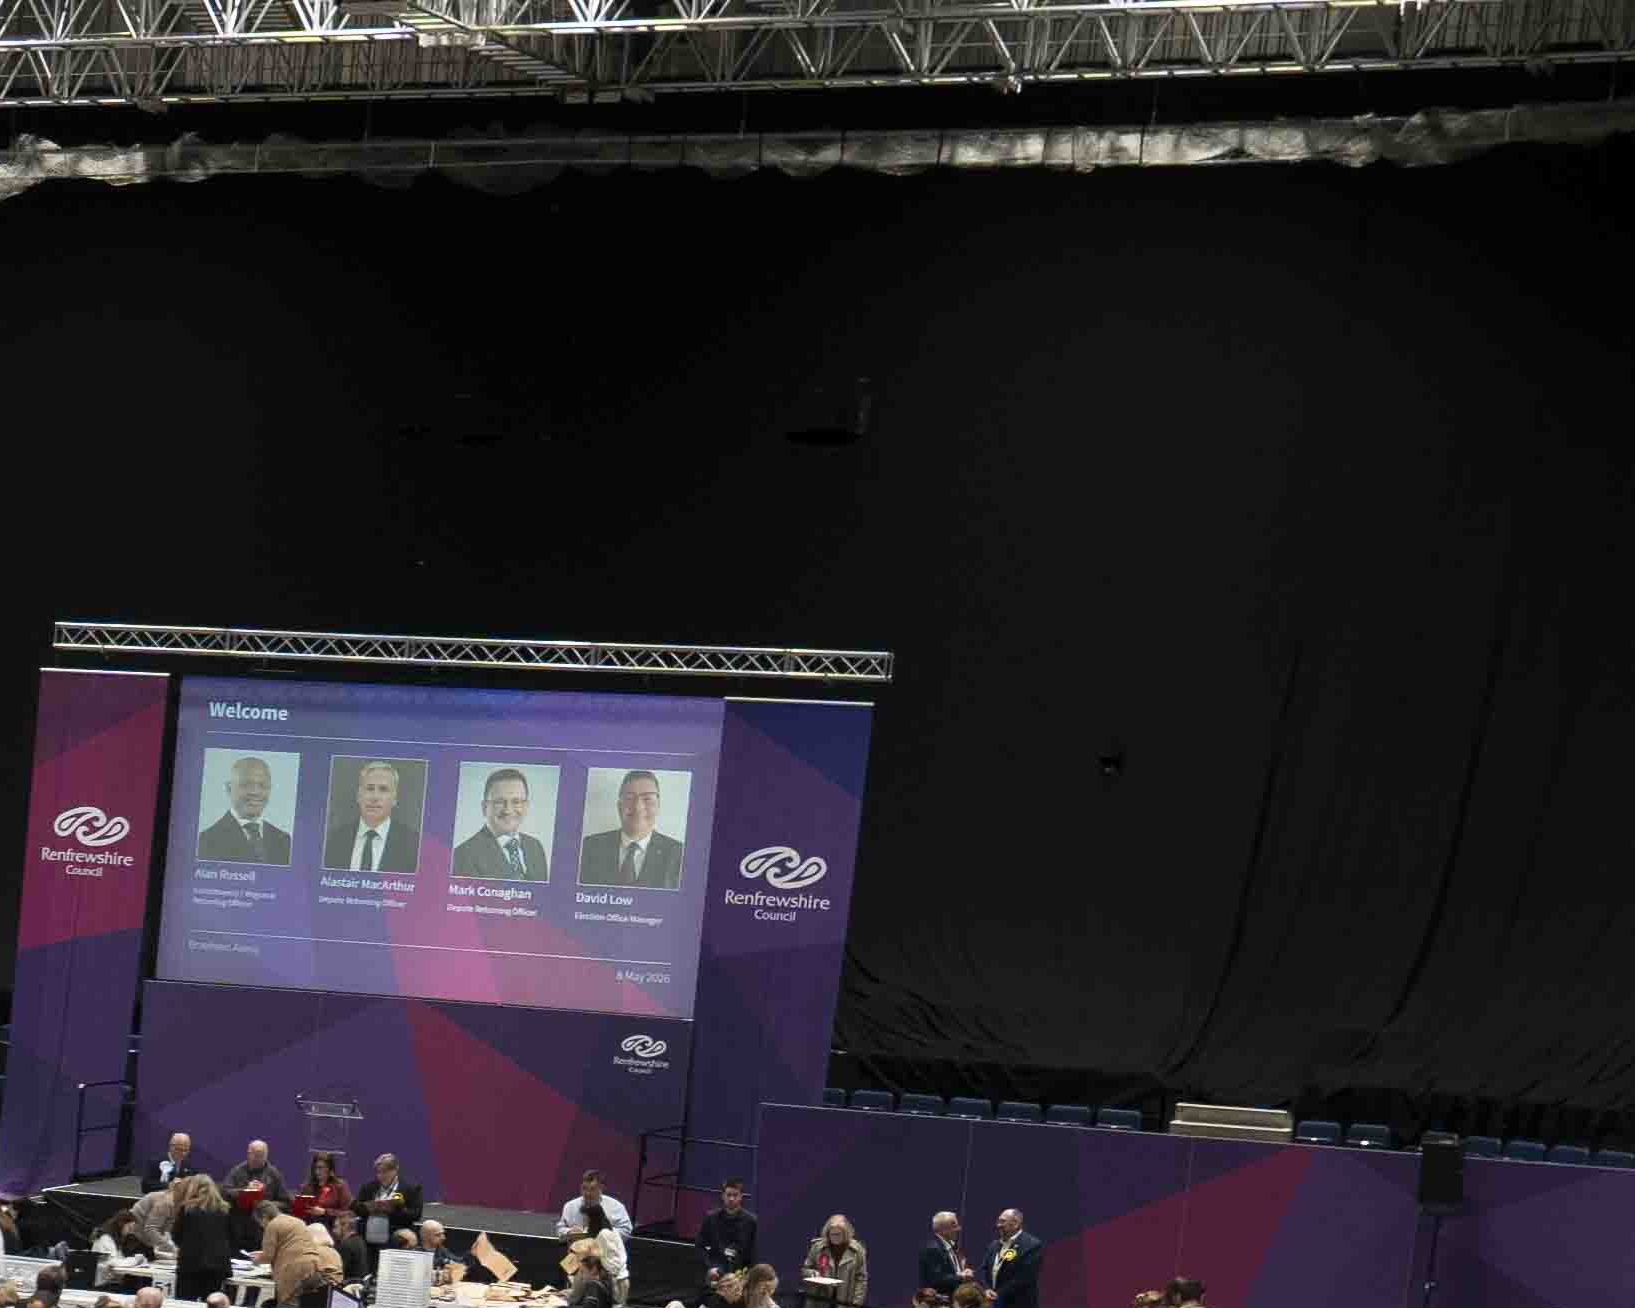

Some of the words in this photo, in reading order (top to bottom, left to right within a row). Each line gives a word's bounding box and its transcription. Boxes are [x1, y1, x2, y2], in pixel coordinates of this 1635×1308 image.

[208, 701, 289, 722] Welcome
[41, 846, 135, 867] Renfrewshire
[64, 864, 103, 878] Council
[320, 875, 360, 890] Alastair
[361, 879, 415, 893] MacArthur
[448, 883, 475, 897] Mark
[477, 886, 532, 904] Conaghan
[575, 892, 607, 905] David
[609, 893, 633, 906] Low
[724, 889, 831, 910] Renfrewshire
[752, 908, 797, 923] Council
